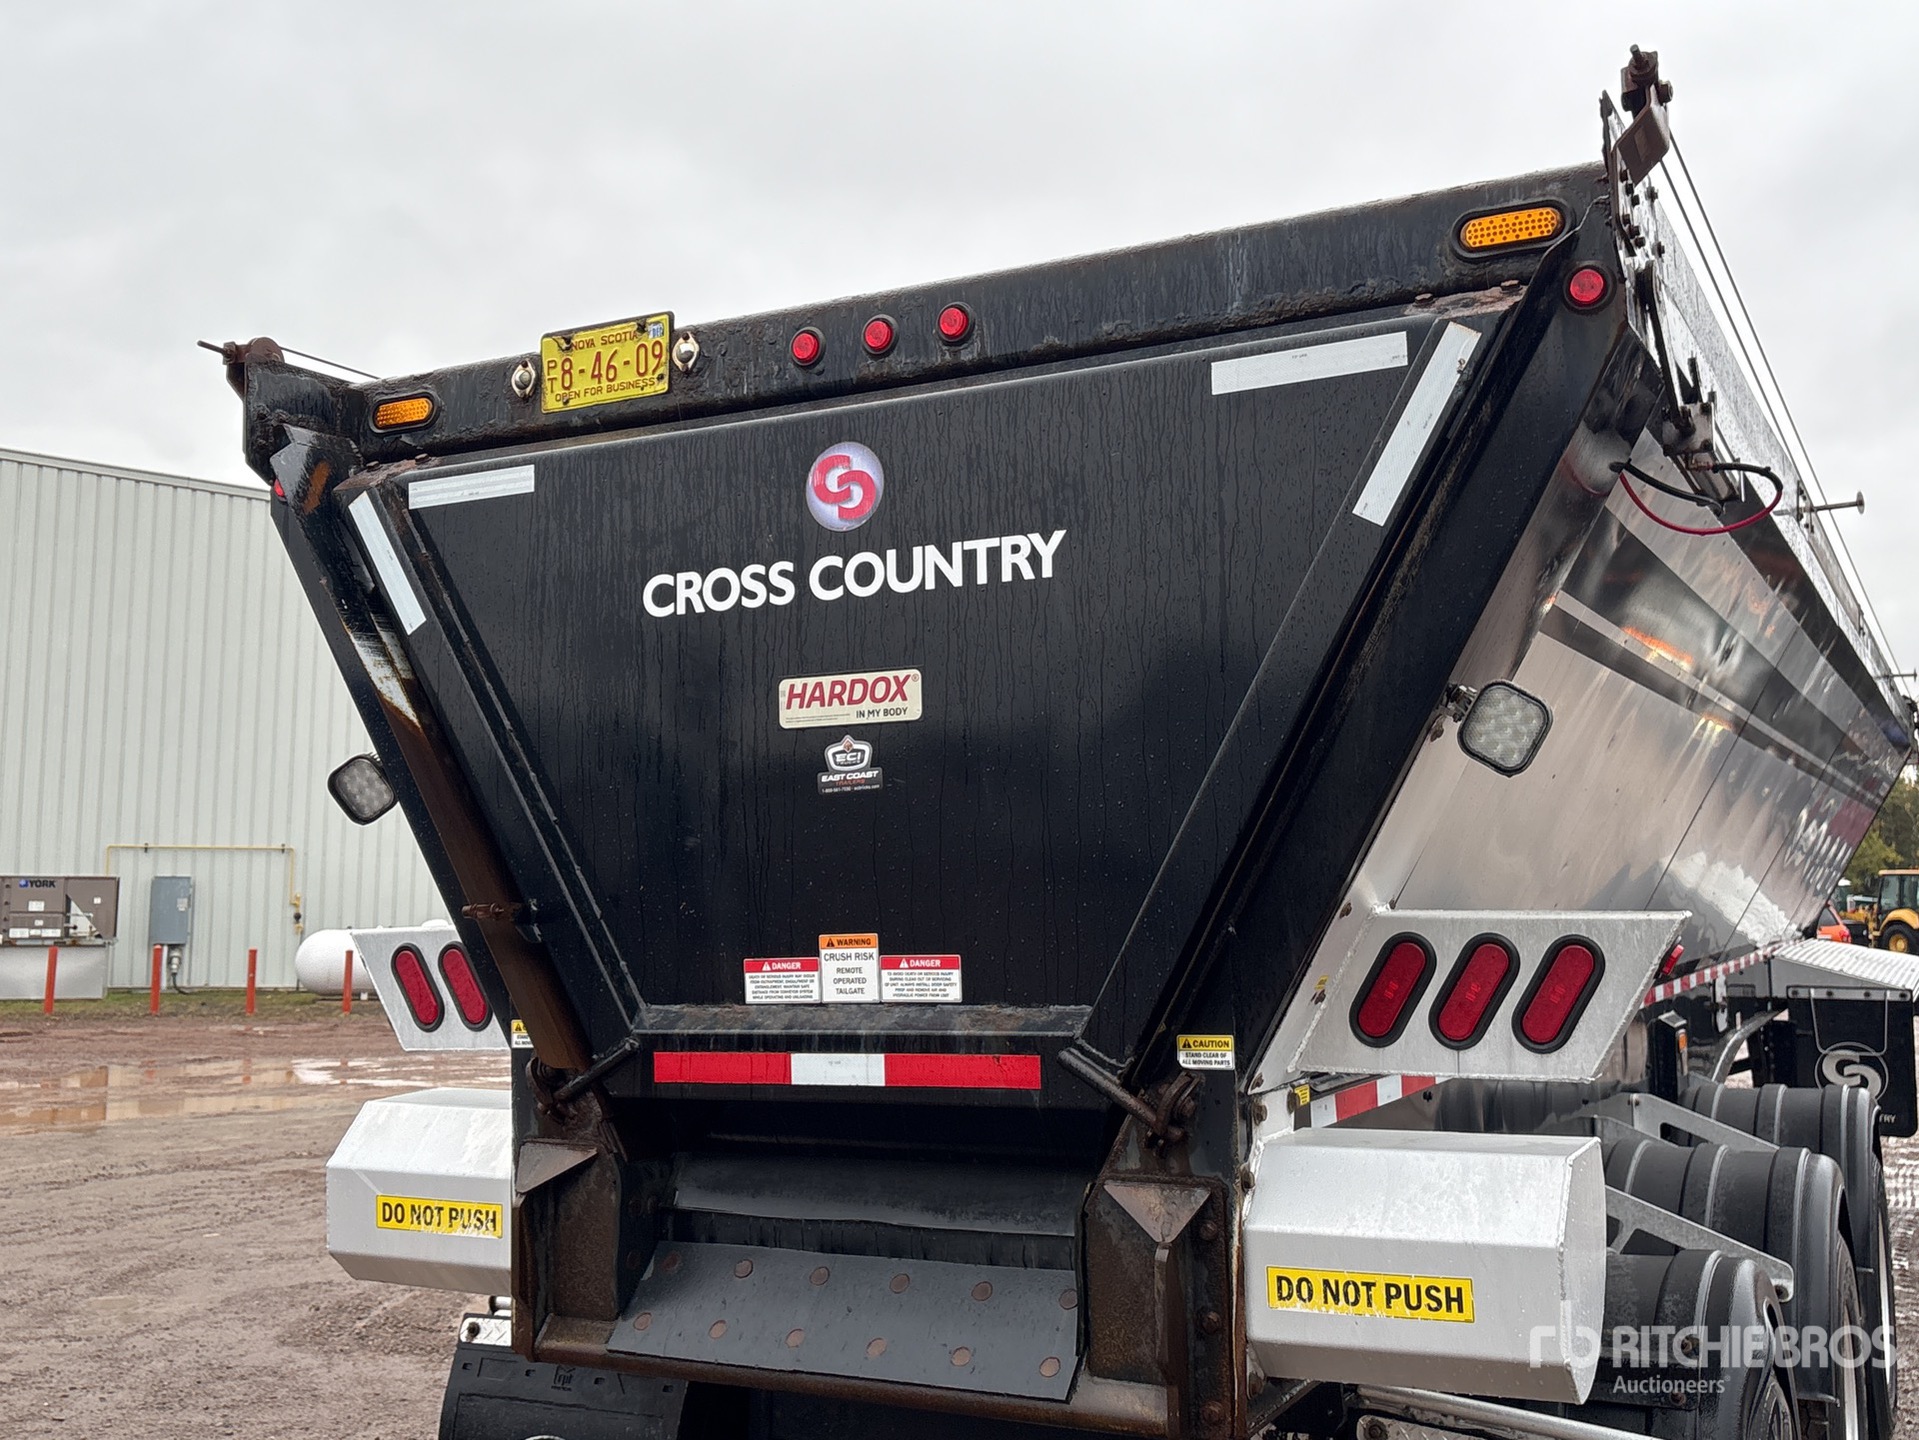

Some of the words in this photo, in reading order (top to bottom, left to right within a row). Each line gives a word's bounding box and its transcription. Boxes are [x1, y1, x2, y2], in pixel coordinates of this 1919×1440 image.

[571, 339, 595, 350] NOVA
[601, 331, 638, 345] SCOTIA
[561, 340, 663, 391] 8-46-09
[555, 390, 580, 402] OPEN
[584, 386, 603, 397] FOR
[606, 377, 655, 393] BUSINESS
[642, 561, 795, 617] CROSS
[809, 529, 1067, 600] COUNTRY
[856, 710, 865, 718] IN
[868, 709, 881, 718] MY
[883, 707, 908, 716] BODY
[822, 774, 846, 782] EAST
[846, 771, 879, 779] COAST
[30, 880, 55, 888] YORK
[837, 938, 871, 946] WARNING
[824, 952, 852, 961] CRUSH
[855, 952, 874, 960] RISK
[772, 962, 801, 970] DANGER
[910, 959, 941, 967] DANGER
[1193, 1040, 1229, 1048] CAUTION
[382, 1202, 405, 1223] DO
[410, 1204, 444, 1227] NOT
[448, 1207, 497, 1232] PUSH
[1276, 1275, 1313, 1303] DO
[1323, 1278, 1376, 1308] NOT
[1385, 1282, 1464, 1313] PUSH
